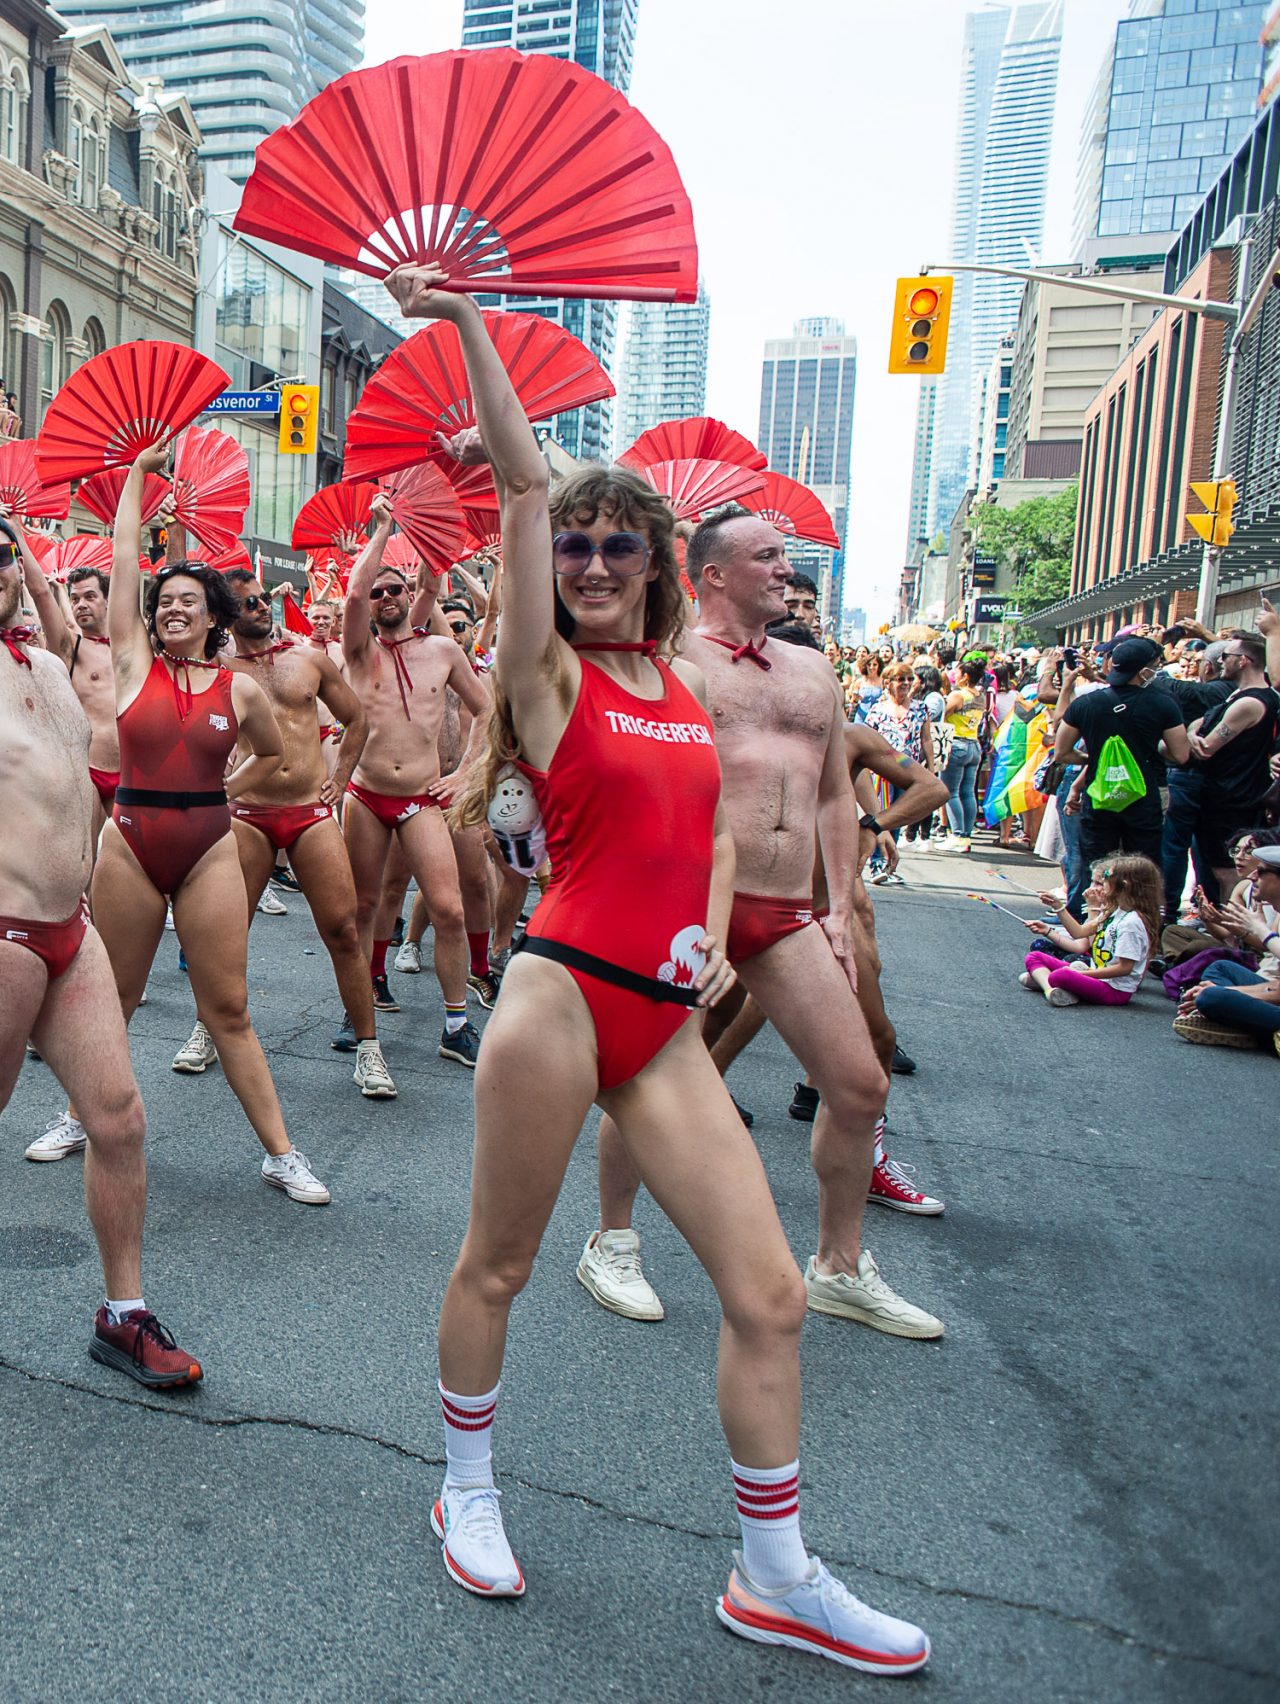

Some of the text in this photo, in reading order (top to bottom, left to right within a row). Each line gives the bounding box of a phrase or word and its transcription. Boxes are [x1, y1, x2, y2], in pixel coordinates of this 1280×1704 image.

[208, 394, 273, 409] osvenor St
[23, 516, 52, 531] A&W
[274, 556, 282, 567] FOR
[282, 559, 296, 570] LEASE
[981, 603, 1007, 613] EVOLV
[604, 710, 714, 747] TRIGGERFISH
[1104, 791, 1128, 801] Pride
